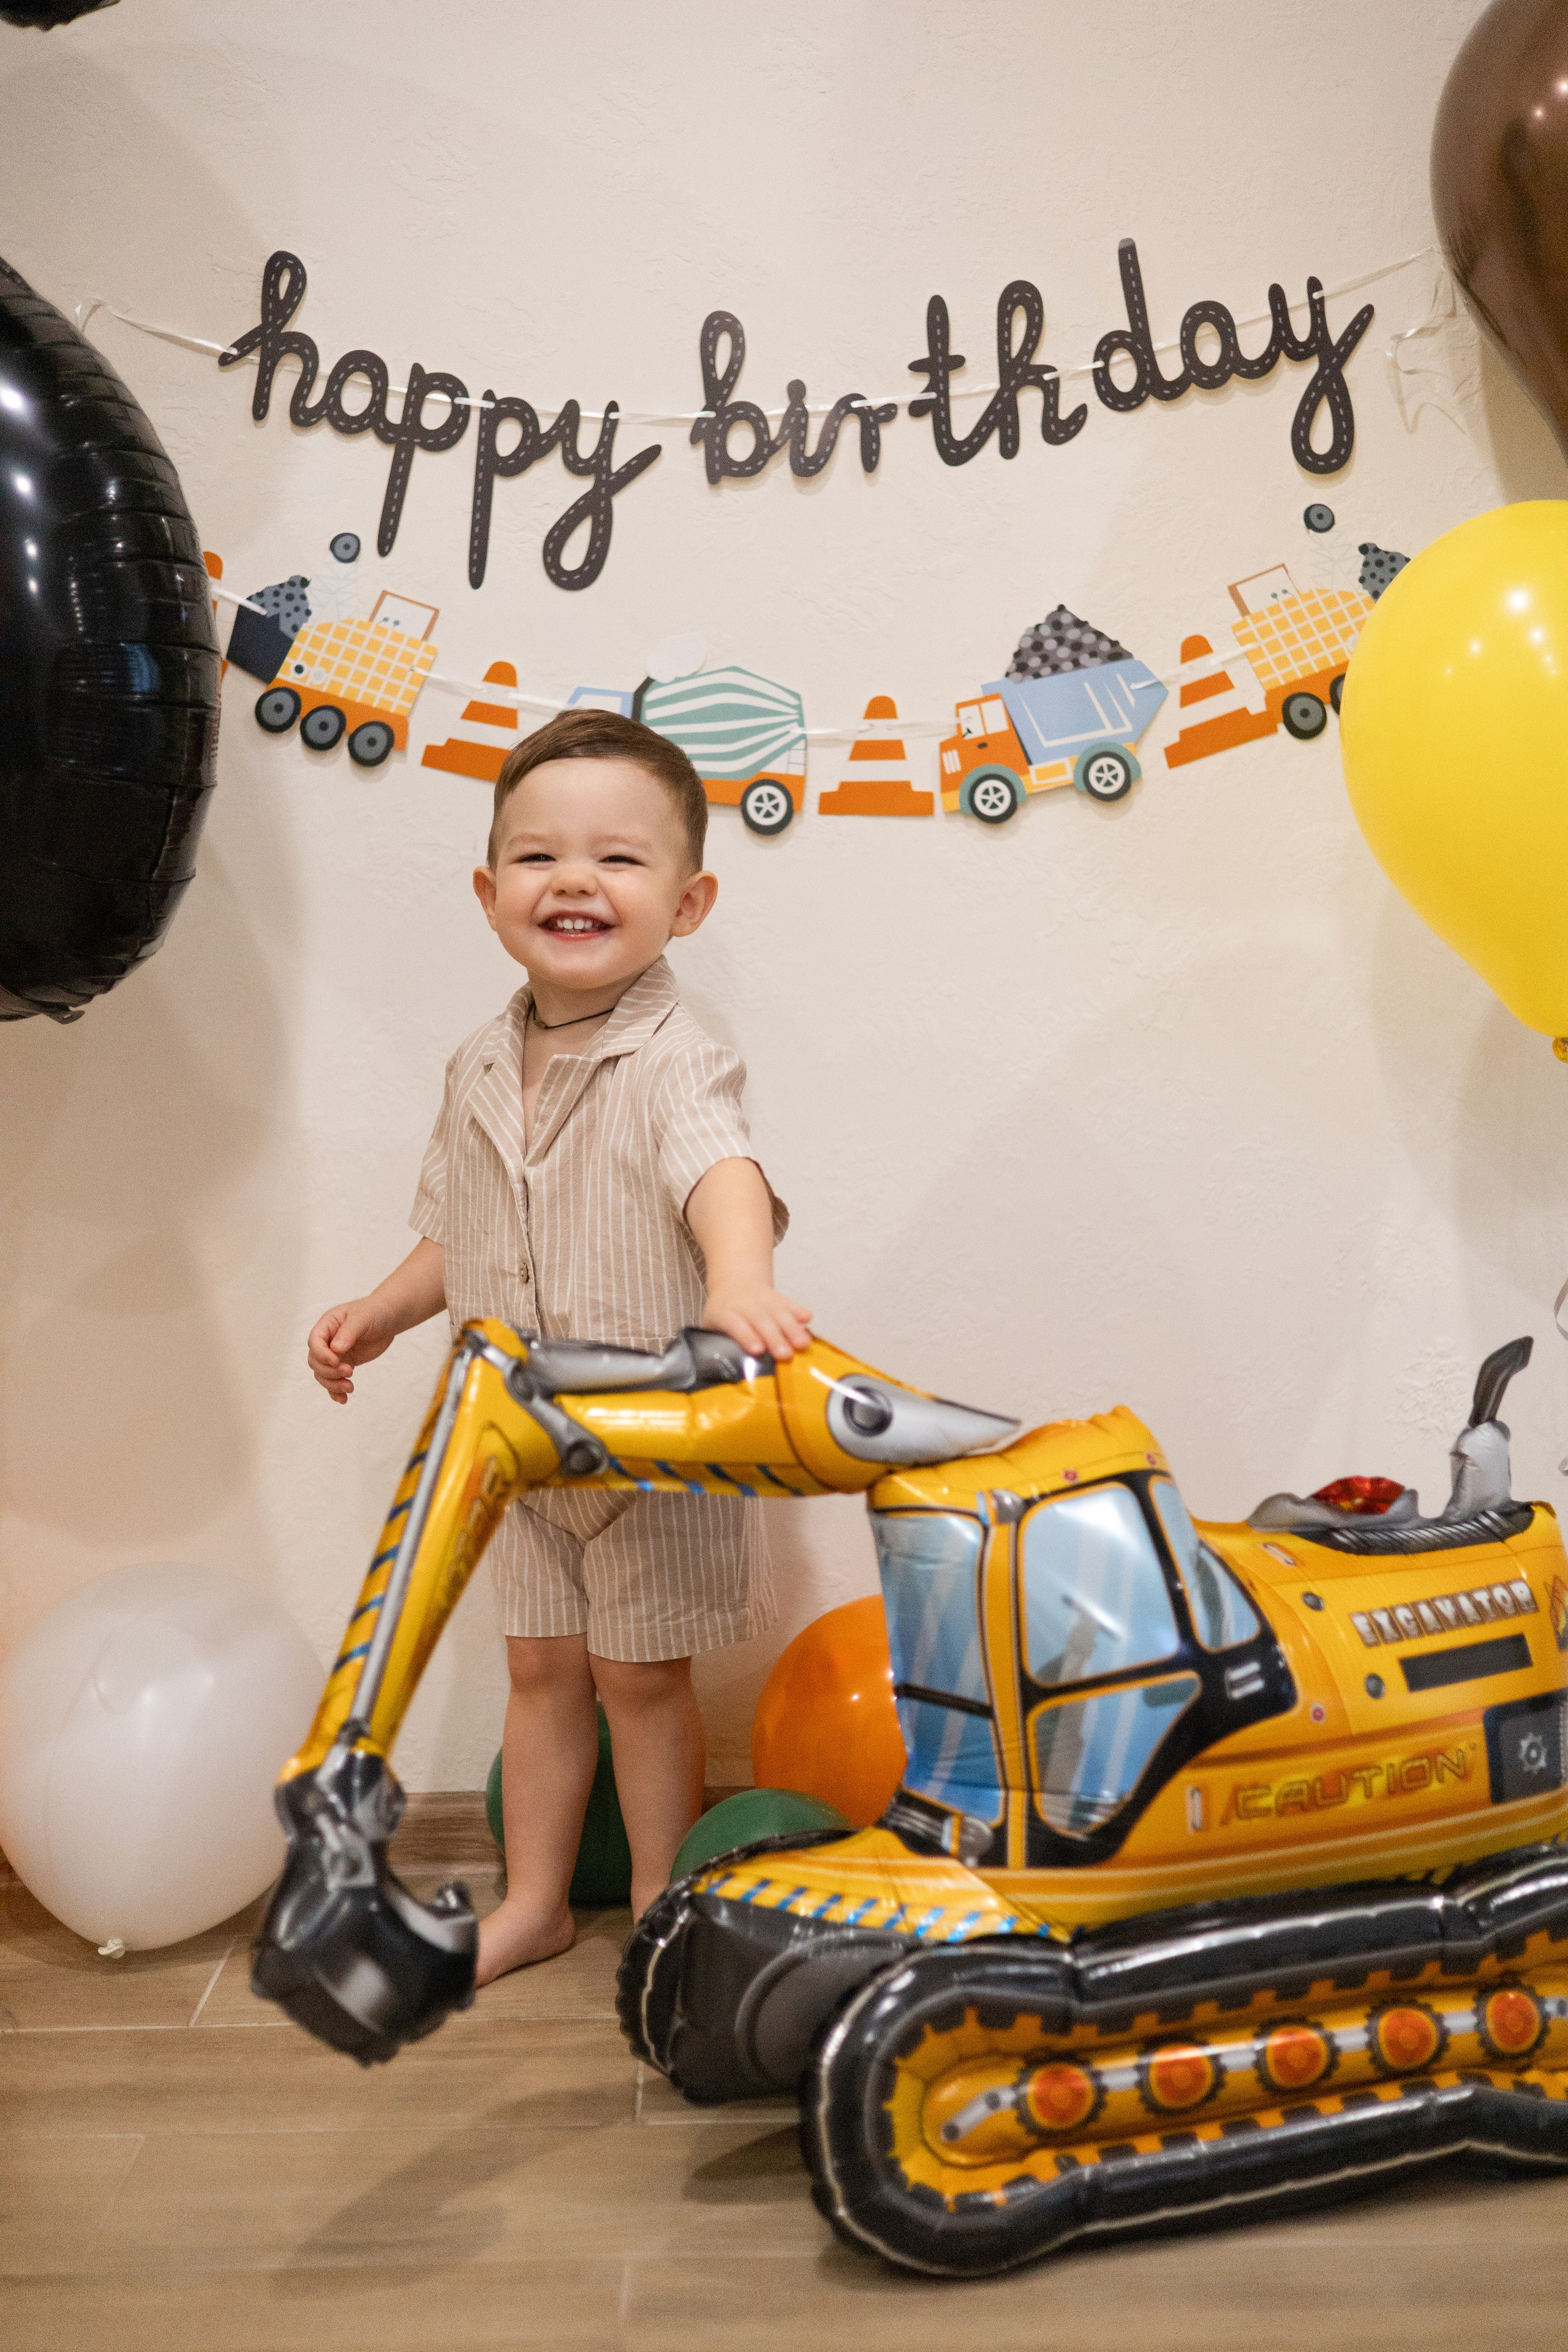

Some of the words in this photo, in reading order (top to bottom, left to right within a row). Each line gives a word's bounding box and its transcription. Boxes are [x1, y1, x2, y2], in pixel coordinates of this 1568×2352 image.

[218, 251, 662, 590] happy
[690, 238, 1374, 485] birthday
[1351, 1579, 1538, 1646] EXCAVATOR
[1235, 1747, 1469, 1820] CAUTION
